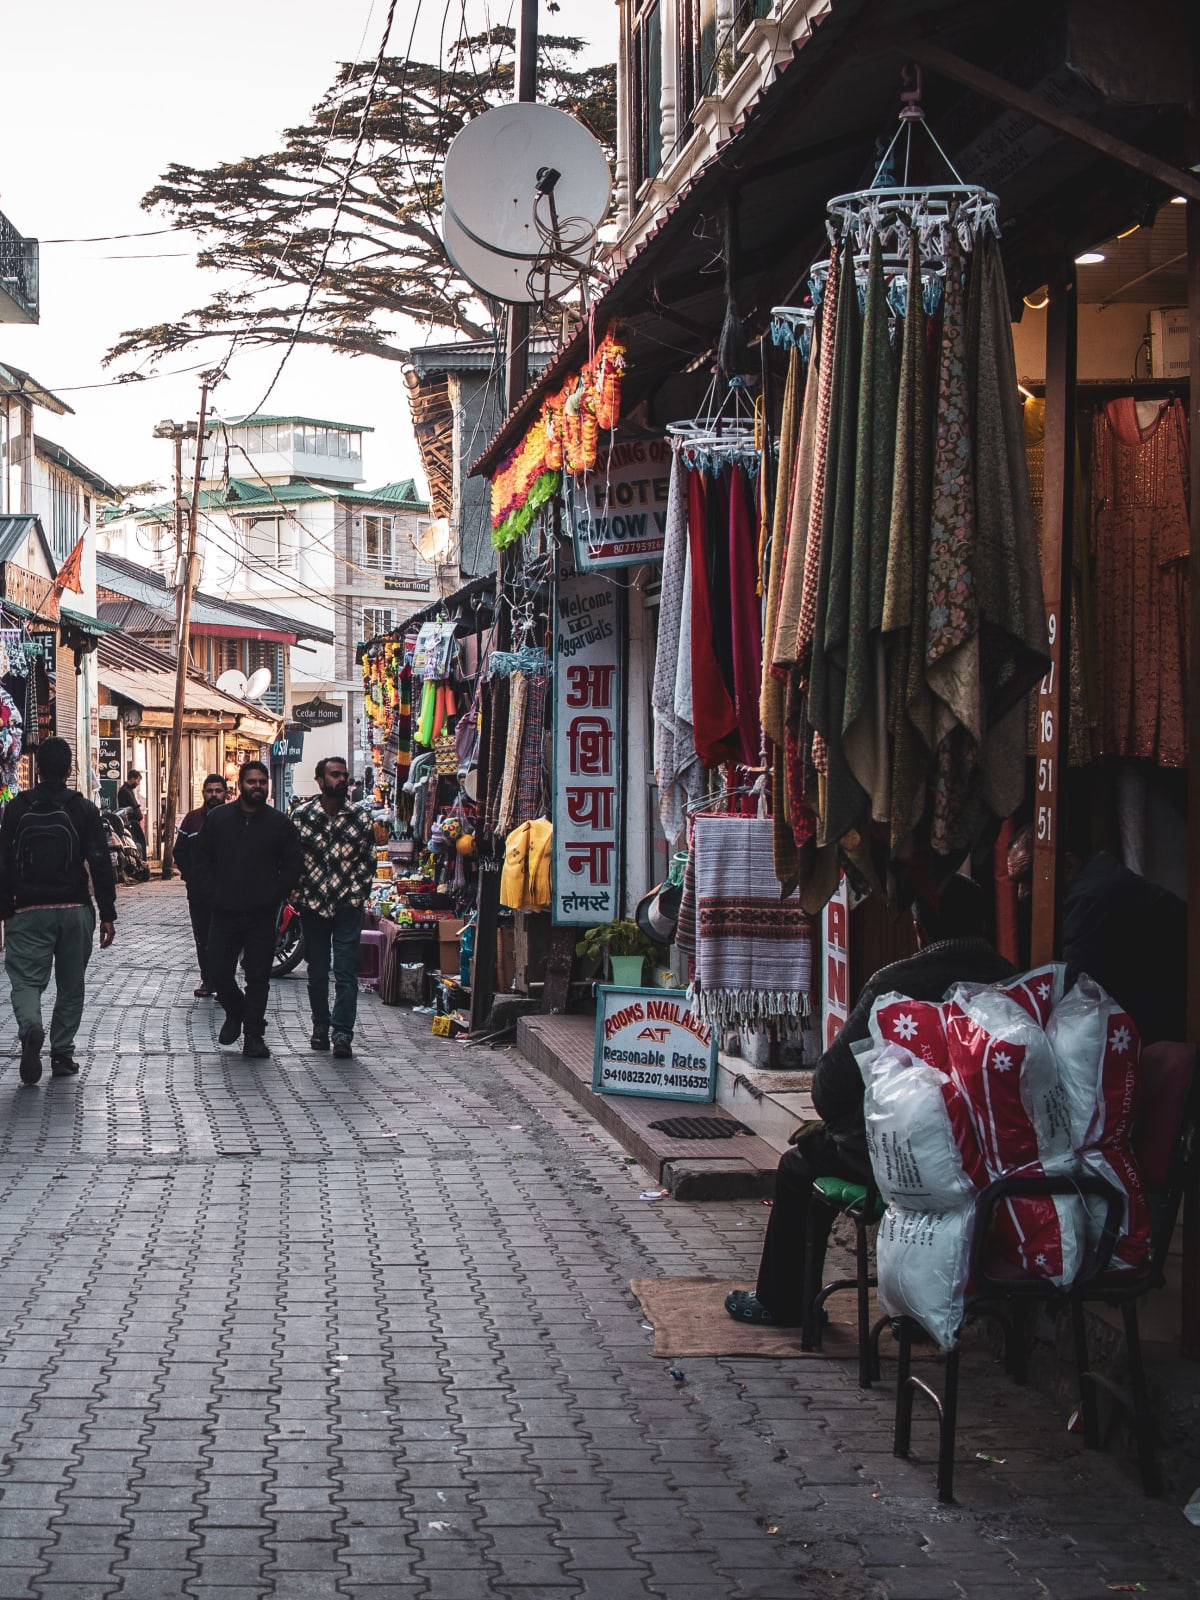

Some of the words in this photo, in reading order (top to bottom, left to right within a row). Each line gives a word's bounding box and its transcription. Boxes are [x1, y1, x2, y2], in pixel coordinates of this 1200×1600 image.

[593, 478, 670, 510] HOTE
[577, 513, 649, 542] SNOW
[558, 591, 614, 619] Welcome
[295, 709, 316, 718] Cedar
[318, 709, 339, 719] Home
[1041, 710, 1053, 743] 16
[1038, 758, 1053, 792] 51
[1037, 806, 1052, 841] 51
[604, 1002, 645, 1040] ROOMS
[636, 1027, 671, 1043] AT
[603, 1046, 665, 1067] Reasonable
[672, 1052, 707, 1070] Rates
